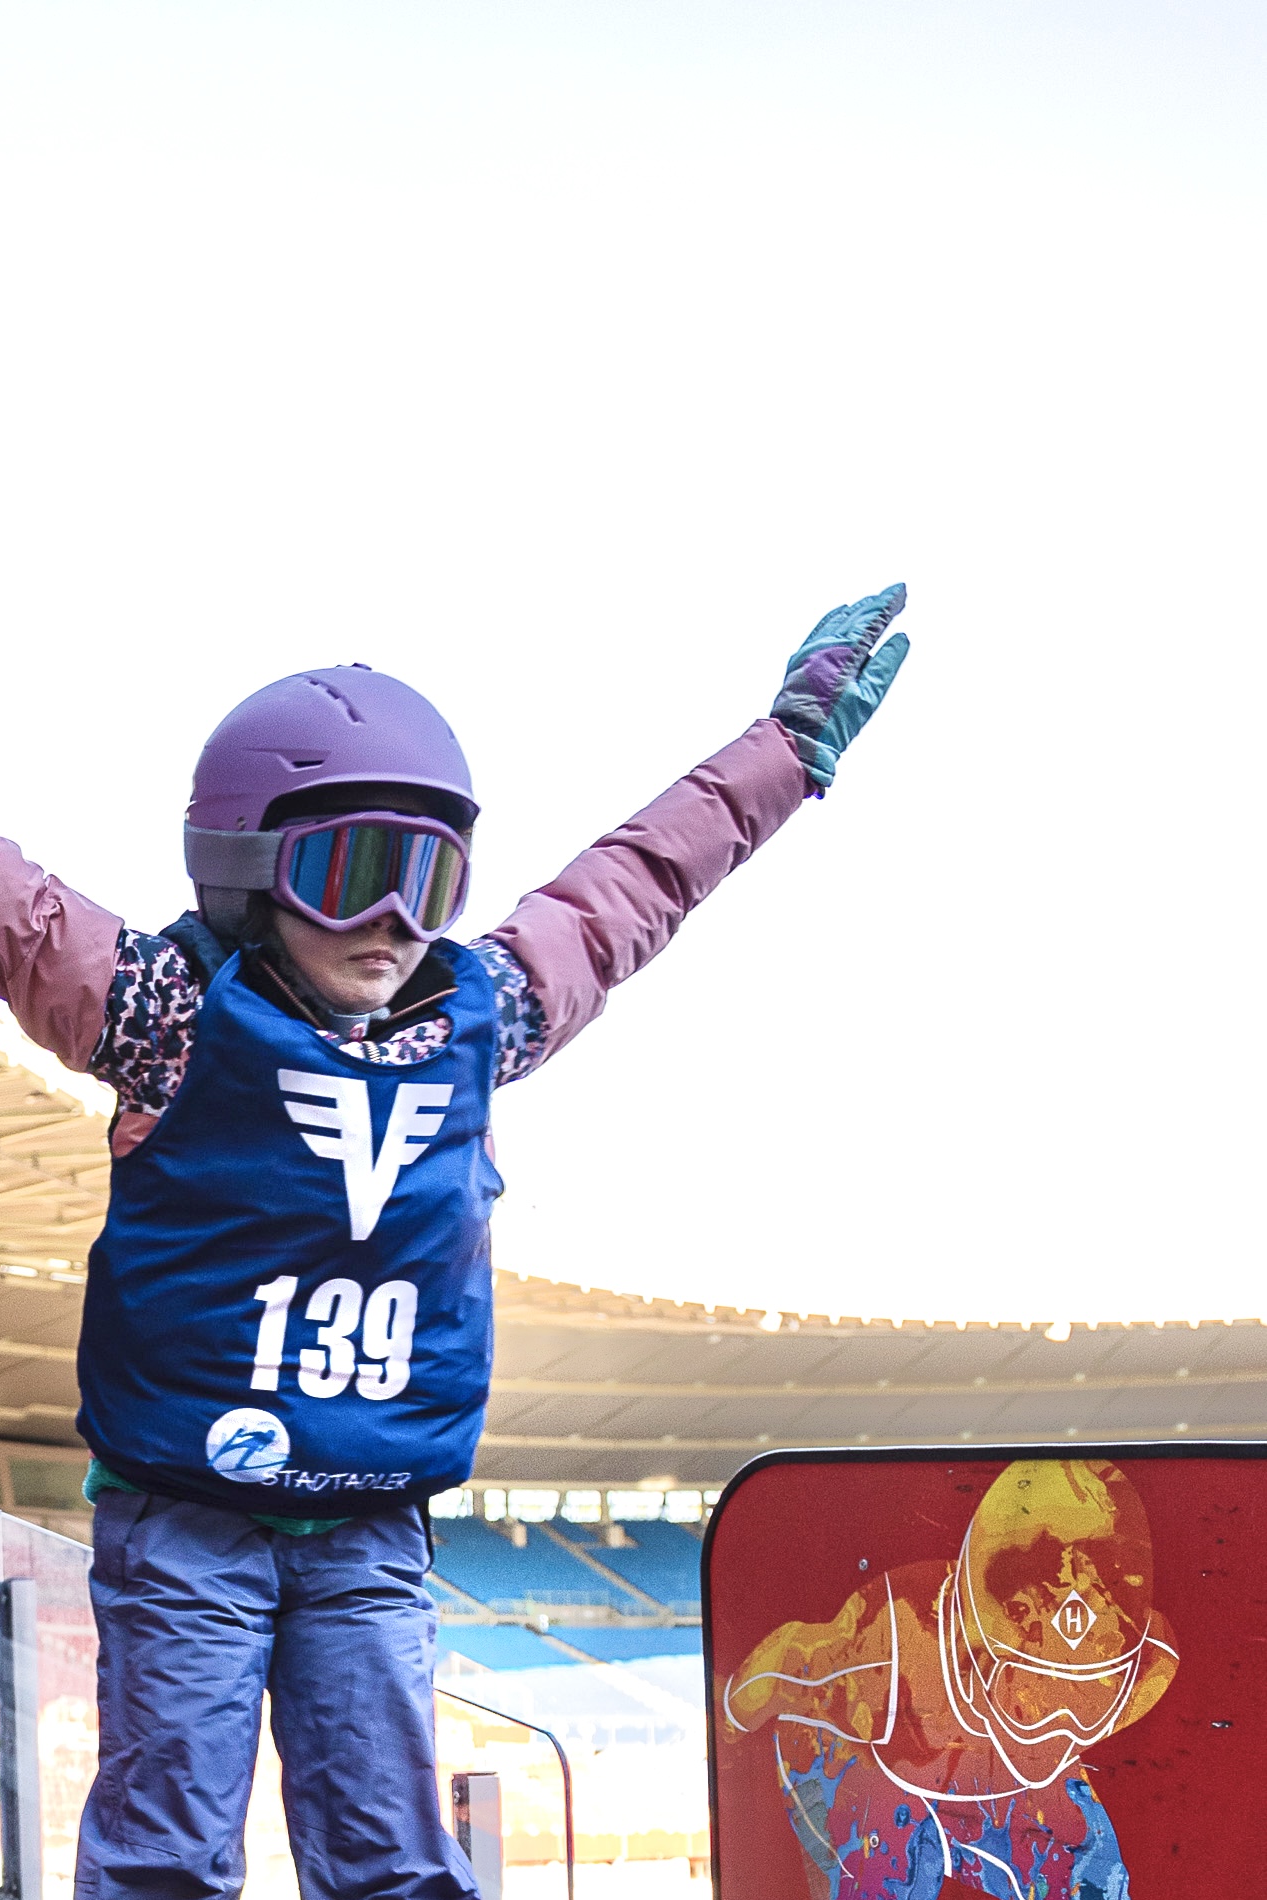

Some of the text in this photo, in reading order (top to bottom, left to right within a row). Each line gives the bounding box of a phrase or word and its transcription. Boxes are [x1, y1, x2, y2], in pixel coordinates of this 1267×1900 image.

[250, 1275, 419, 1400] 139
[262, 1469, 412, 1491] STADTADLER
[1065, 1606, 1082, 1634] H
